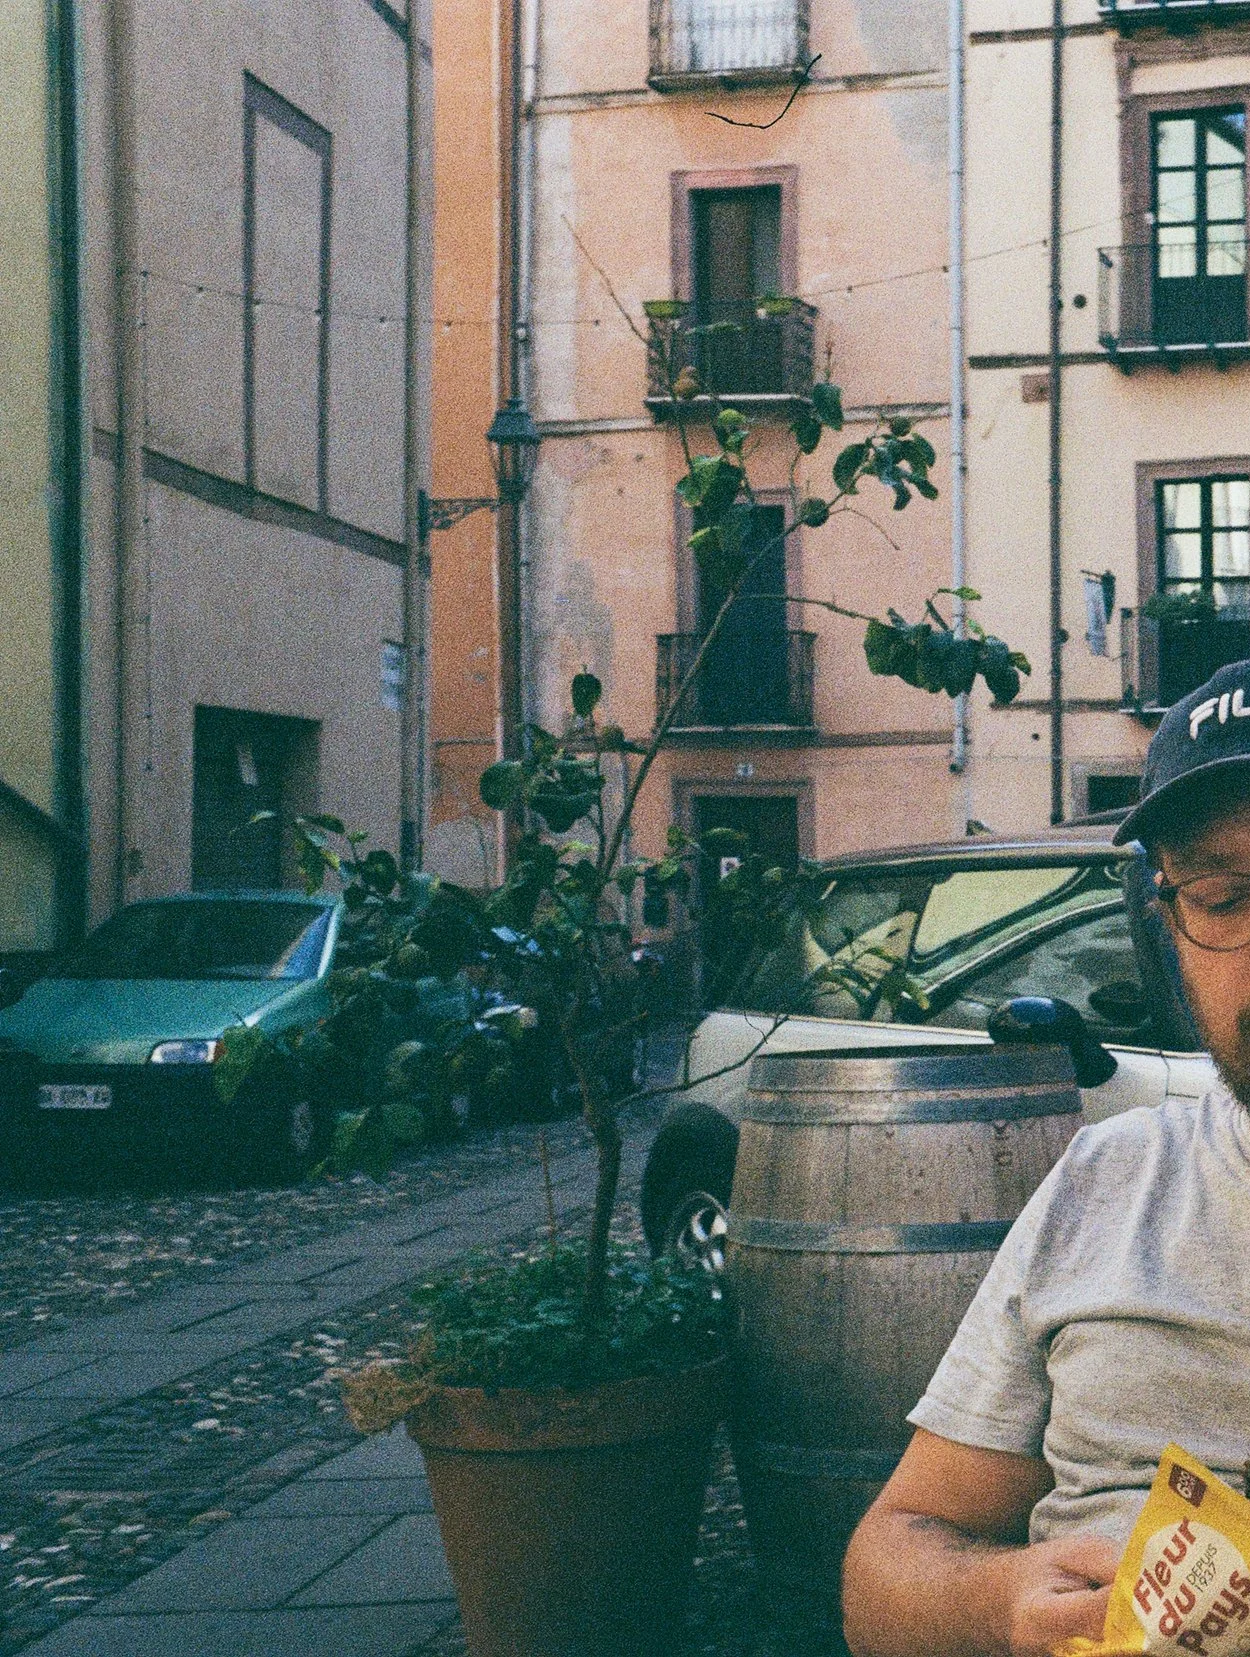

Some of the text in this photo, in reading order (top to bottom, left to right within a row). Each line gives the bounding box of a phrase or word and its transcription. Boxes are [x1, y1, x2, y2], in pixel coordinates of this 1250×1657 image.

[1133, 1516, 1196, 1615] Fleur
[1185, 1543, 1218, 1586] DEPUIS
[1194, 1561, 1216, 1593] 1937
[1158, 1583, 1196, 1637] du
